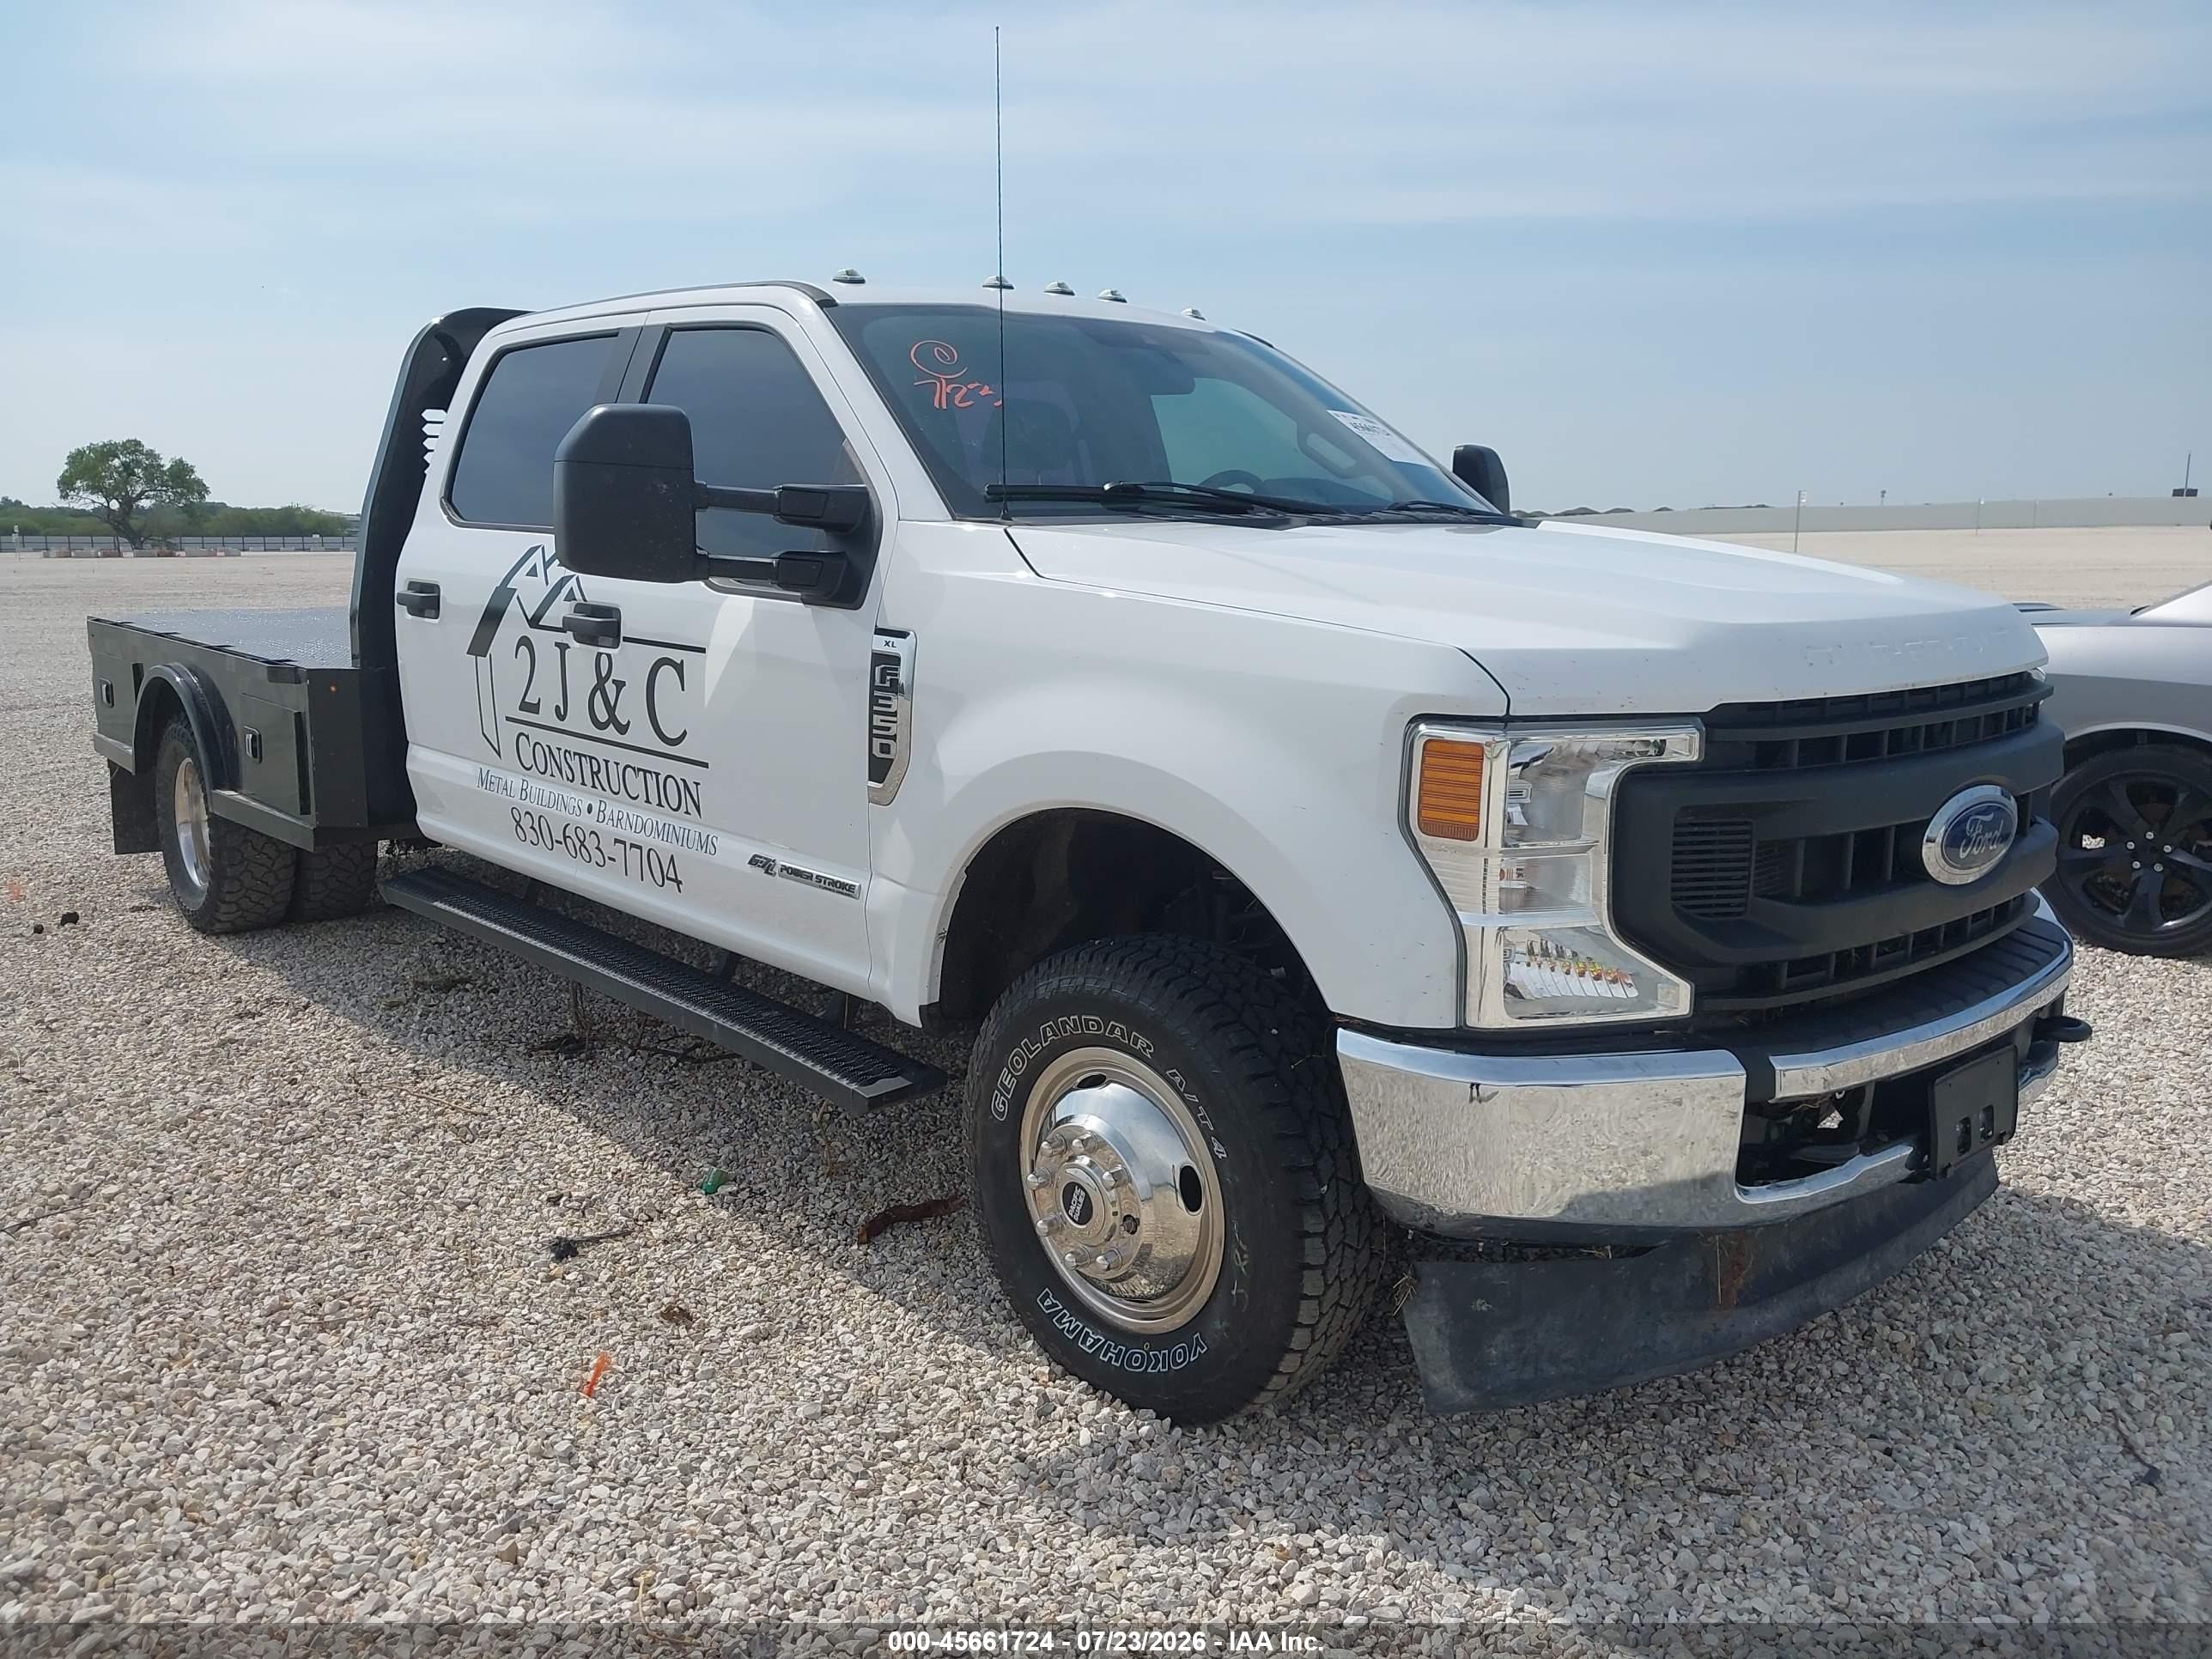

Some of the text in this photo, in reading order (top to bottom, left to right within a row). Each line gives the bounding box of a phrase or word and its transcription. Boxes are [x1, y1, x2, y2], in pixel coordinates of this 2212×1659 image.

[884, 640, 896, 648] XL
[477, 767, 719, 856] METAL BUILDINGS BARNDOMINIUMS
[515, 732, 702, 819] CONSTRUCTION
[510, 806, 684, 894] 830-683-7704
[1959, 811, 2004, 859] Ford
[780, 864, 814, 882] POWER
[815, 874, 857, 894] STROKE
[990, 1015, 1154, 1121] GEOLANDAR
[1068, 1185, 1081, 1218] PACIFIC
[1036, 1287, 1208, 1373] YOKOHAMA
